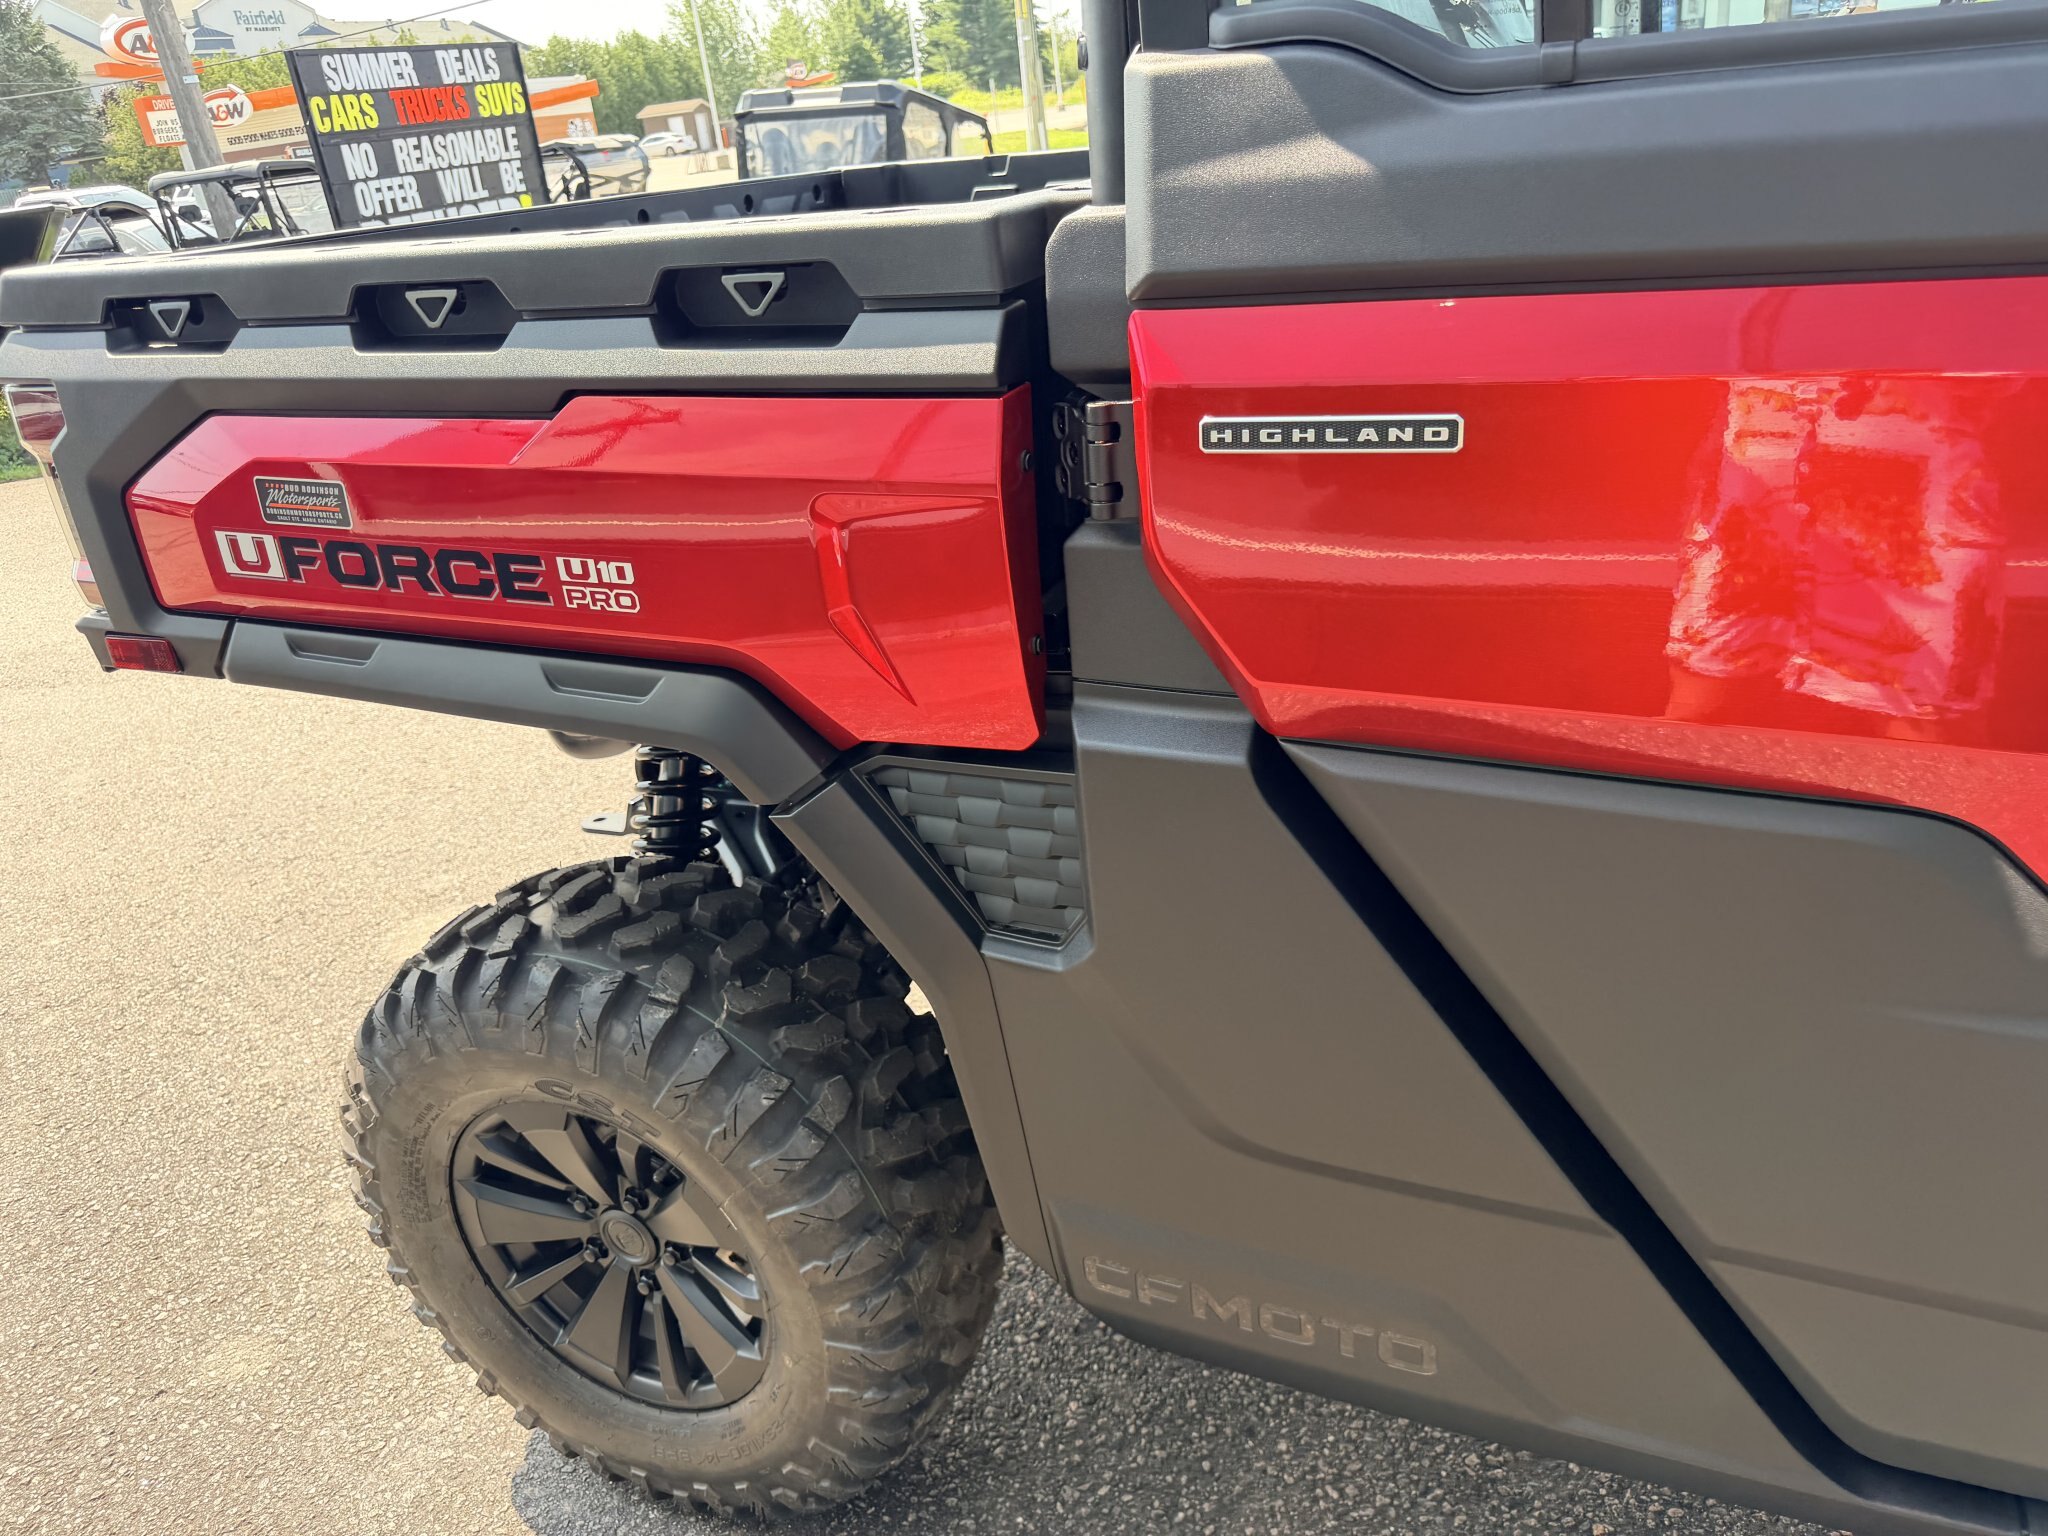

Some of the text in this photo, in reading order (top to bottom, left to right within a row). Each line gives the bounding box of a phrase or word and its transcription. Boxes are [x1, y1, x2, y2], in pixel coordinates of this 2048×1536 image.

[232, 10, 286, 25] Fairfield
[321, 48, 501, 92] SUMMER DEALS
[151, 98, 176, 110] DRIVE
[310, 82, 527, 133] CARS TRUCKS SUVS
[340, 126, 522, 180] NO REASONABLE
[354, 175, 424, 217] OFFER
[436, 165, 489, 203] WILL
[499, 159, 527, 194] BE
[1210, 427, 1449, 443] HIGHLAND
[266, 489, 342, 510] Motorsports
[284, 484, 339, 495] BUD ROBINSON
[555, 556, 635, 585] U10
[563, 587, 641, 614] PRO
[534, 1077, 662, 1138] CST
[1083, 1256, 1438, 1376] CFMOTO
